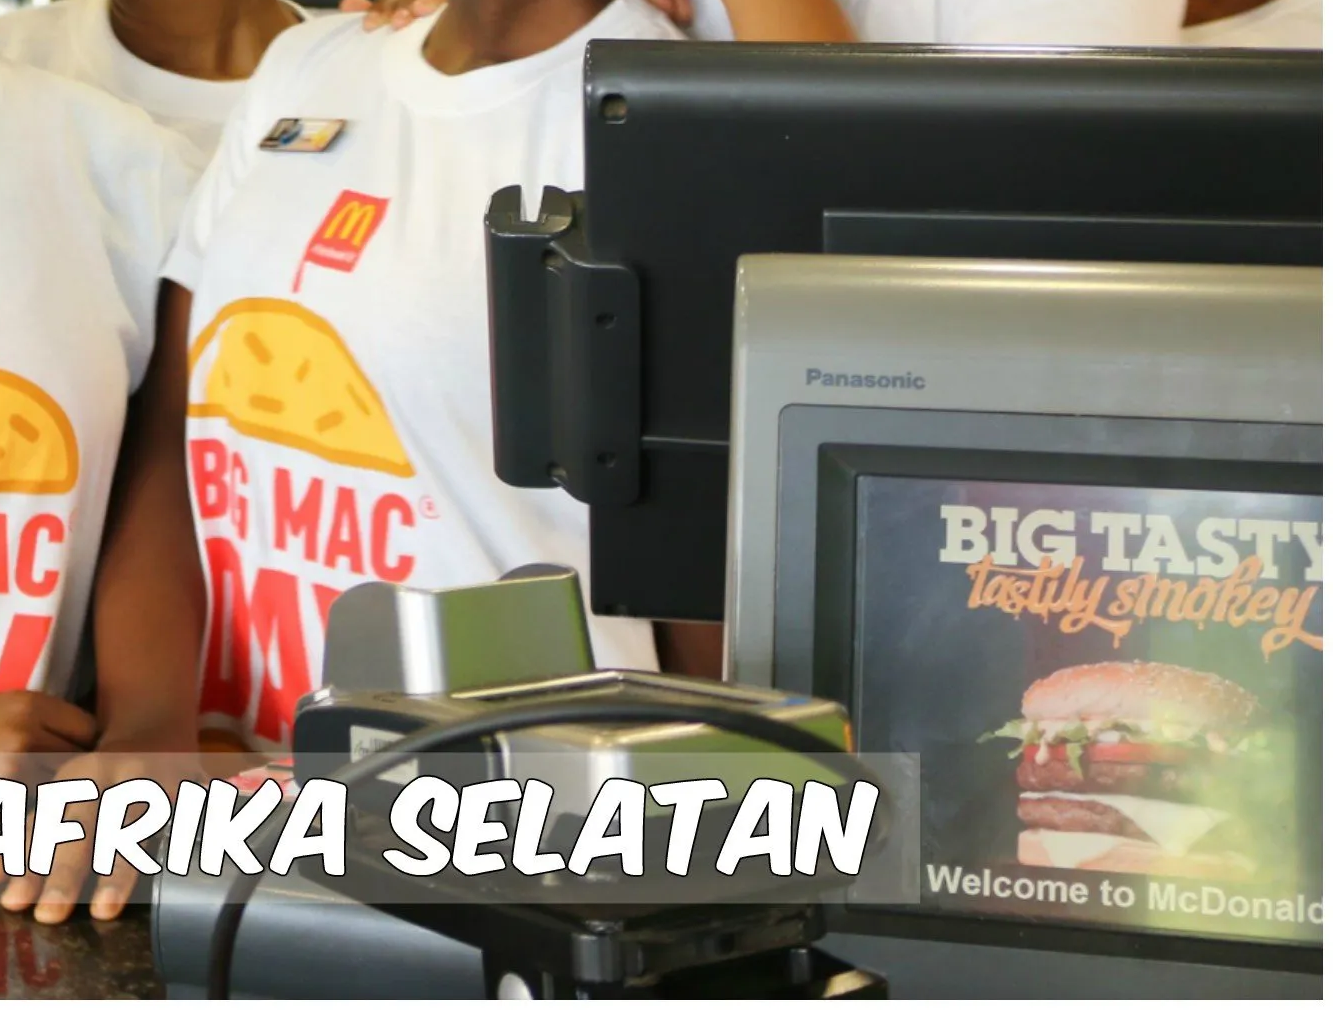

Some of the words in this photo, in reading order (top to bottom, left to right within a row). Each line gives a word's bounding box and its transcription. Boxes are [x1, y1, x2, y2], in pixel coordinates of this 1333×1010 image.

[806, 368, 926, 390] Panasonic
[190, 438, 250, 542] BG
[273, 466, 416, 582] MAC
[939, 504, 1077, 570] BIG
[965, 554, 1132, 650] tastily
[1109, 555, 1322, 663] smokey
[926, 863, 1090, 905] Welcome
[1100, 878, 1135, 909] to
